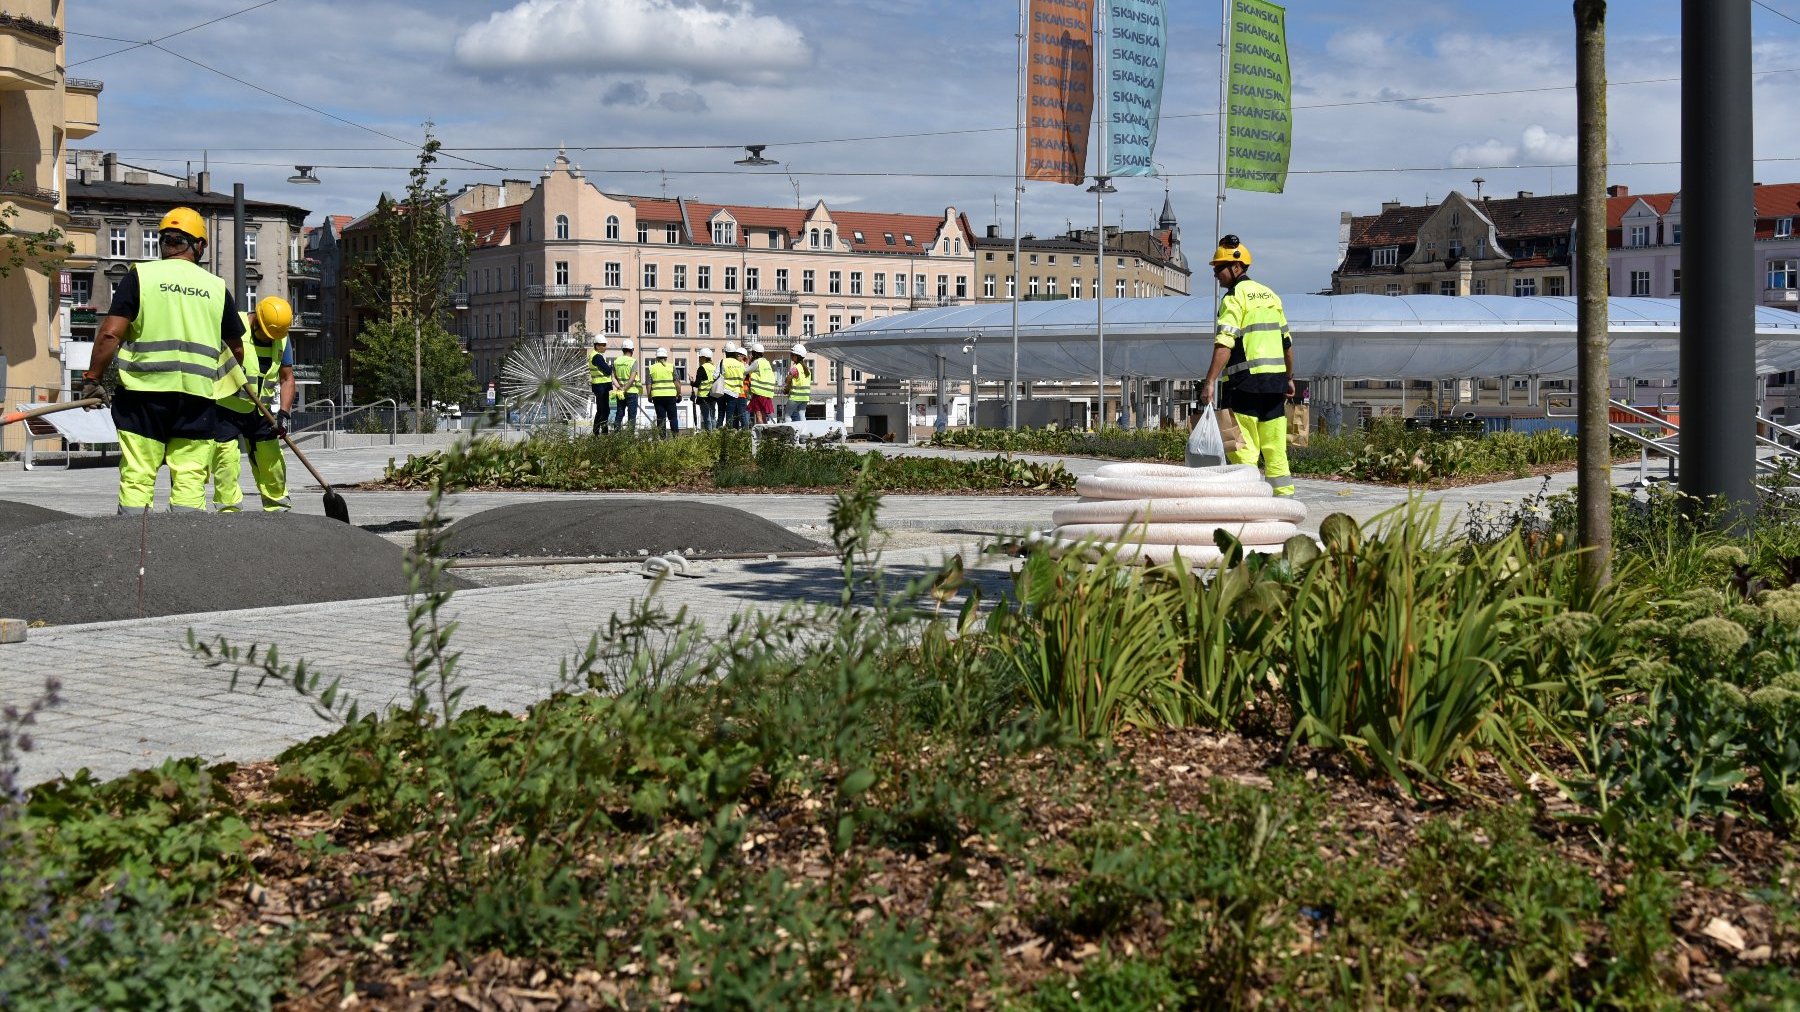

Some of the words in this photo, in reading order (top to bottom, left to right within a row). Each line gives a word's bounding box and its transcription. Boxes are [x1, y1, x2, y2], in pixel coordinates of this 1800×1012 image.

[1112, 7, 1160, 27] SKANSKA
[1236, 1, 1280, 26] SKANSKA
[1236, 22, 1281, 46] SKANSKA
[1234, 42, 1283, 65] SKANSKA
[1230, 104, 1288, 123] SKANSKA
[1230, 125, 1286, 144] SKANSKA
[1228, 146, 1282, 164] SKANSKA
[1228, 166, 1278, 183] SKANSKA
[160, 282, 210, 300] SKANSKA
